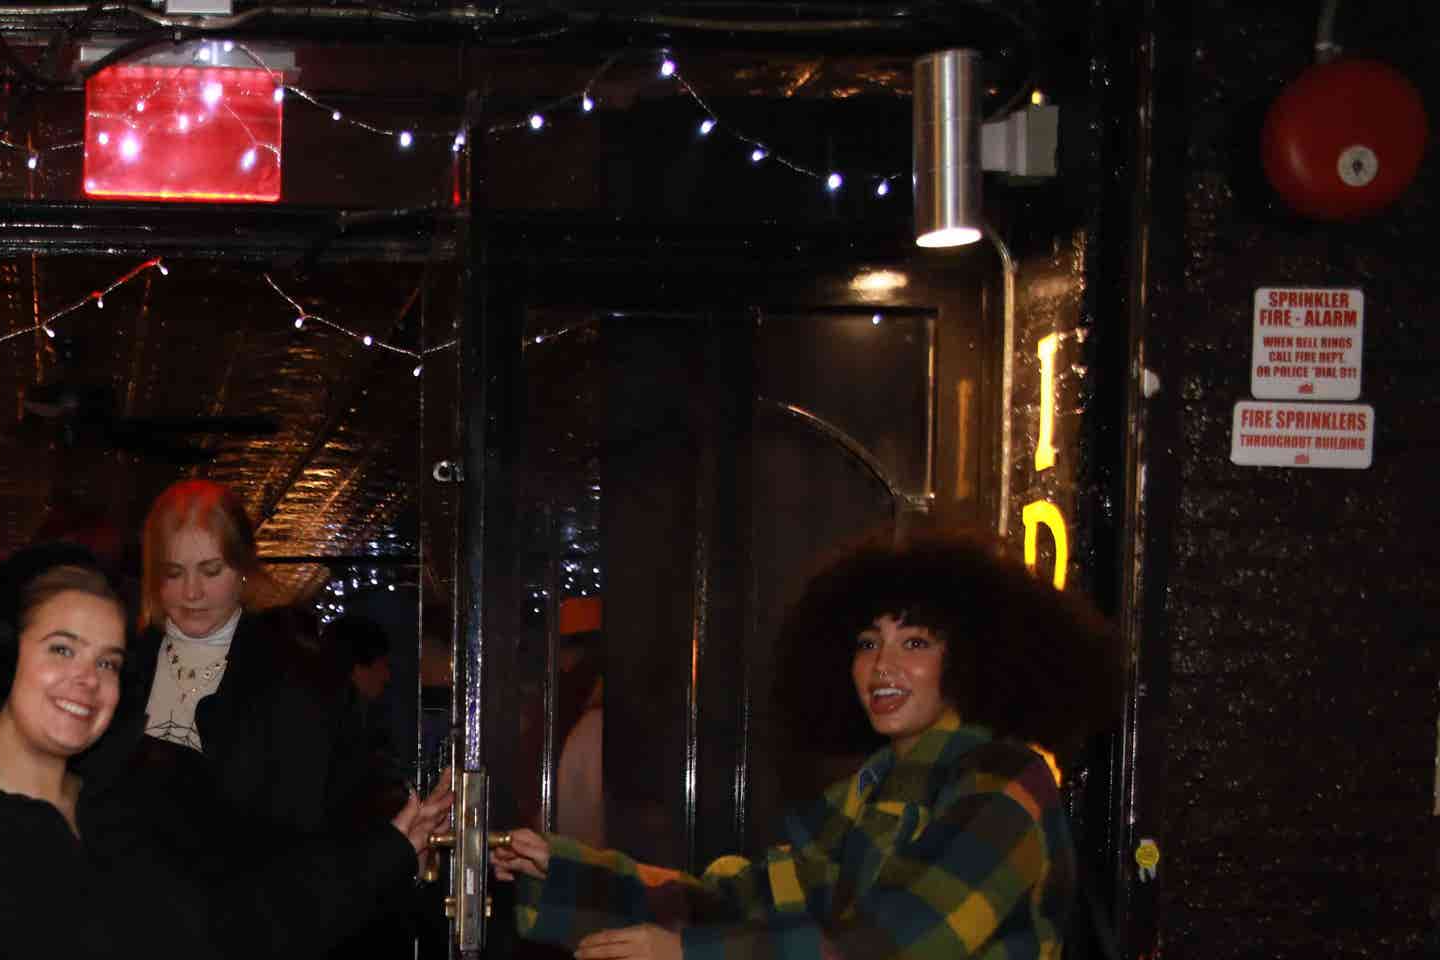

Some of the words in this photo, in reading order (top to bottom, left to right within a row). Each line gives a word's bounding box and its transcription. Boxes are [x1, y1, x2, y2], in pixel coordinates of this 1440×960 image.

[1268, 291, 1350, 309] SPRINKLER
[1259, 309, 1292, 327] FIRE
[1304, 310, 1358, 328] ALARM
[1263, 336, 1294, 348] WHEN
[1296, 336, 1317, 349] BELL
[1320, 336, 1353, 349] RINGS
[1268, 351, 1292, 362] CALL
[1295, 351, 1316, 363] FIRE
[1256, 365, 1270, 378] OR
[1273, 366, 1308, 378] POLICE
[1241, 409, 1272, 429] FIRE
[1276, 410, 1366, 431] SPRINKLERS
[1241, 434, 1312, 449] THROUGHOUT
[1315, 436, 1365, 450] BUILDING
